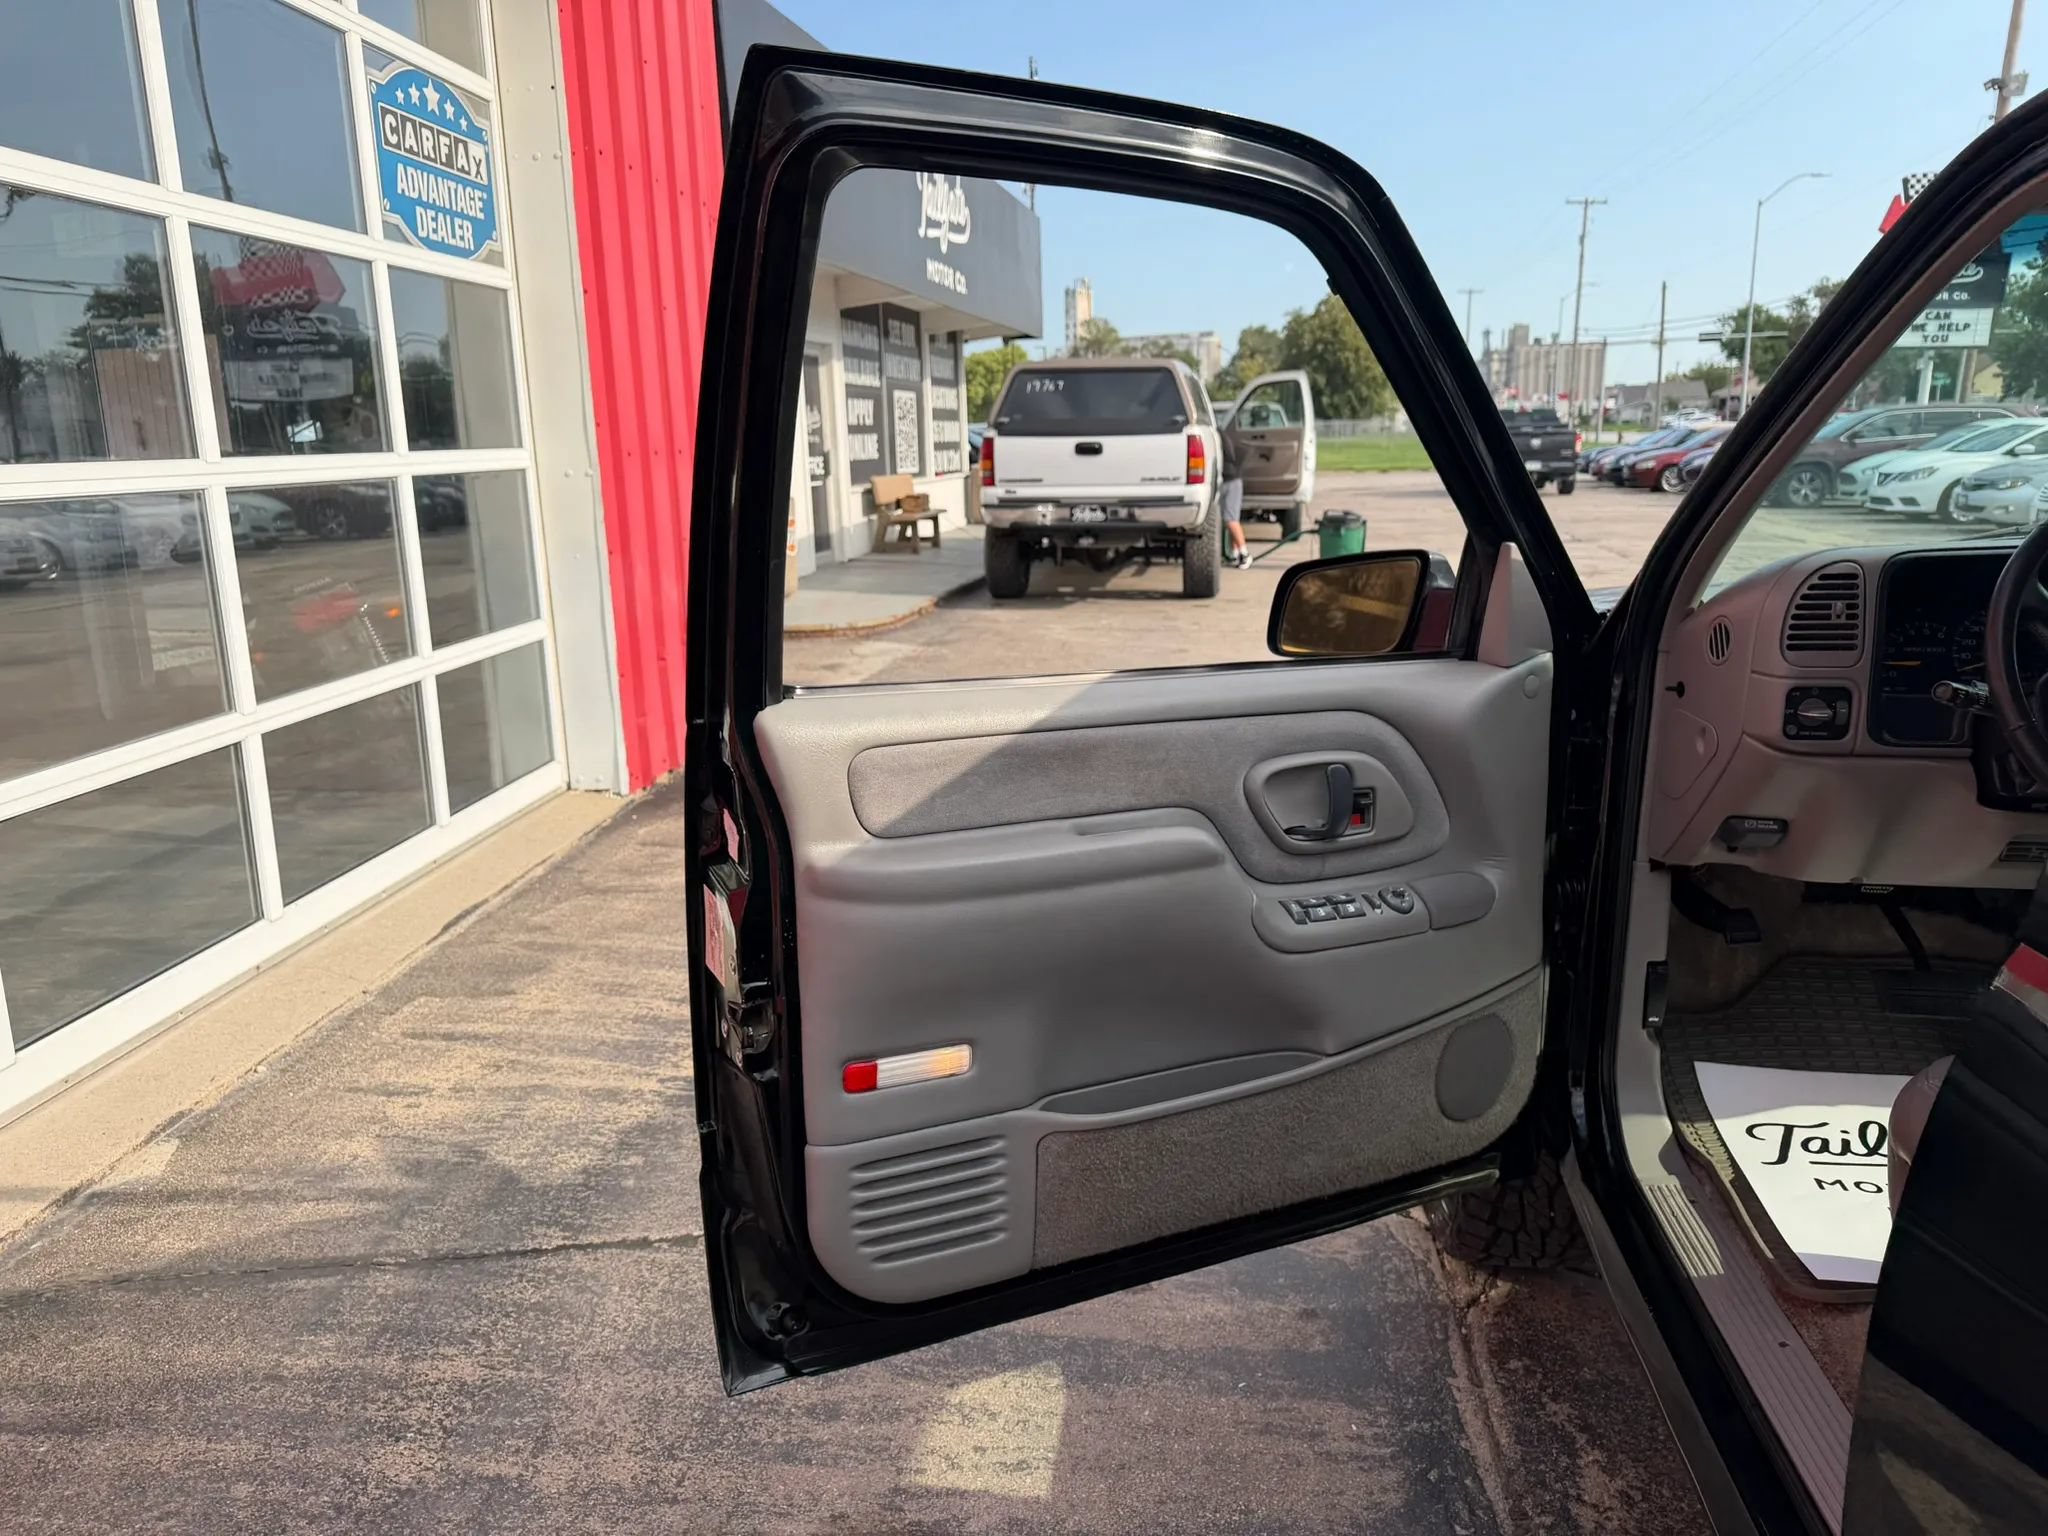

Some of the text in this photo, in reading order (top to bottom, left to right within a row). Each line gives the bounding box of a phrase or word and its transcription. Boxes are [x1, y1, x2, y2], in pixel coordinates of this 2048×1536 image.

[383, 112, 485, 181] CARFAX
[397, 162, 486, 220] ADVANTAGE
[415, 206, 475, 250] DEALER
[1925, 312, 1952, 321] CAN
[1938, 322, 1971, 332] HELP
[1922, 335, 1949, 343] YOU
